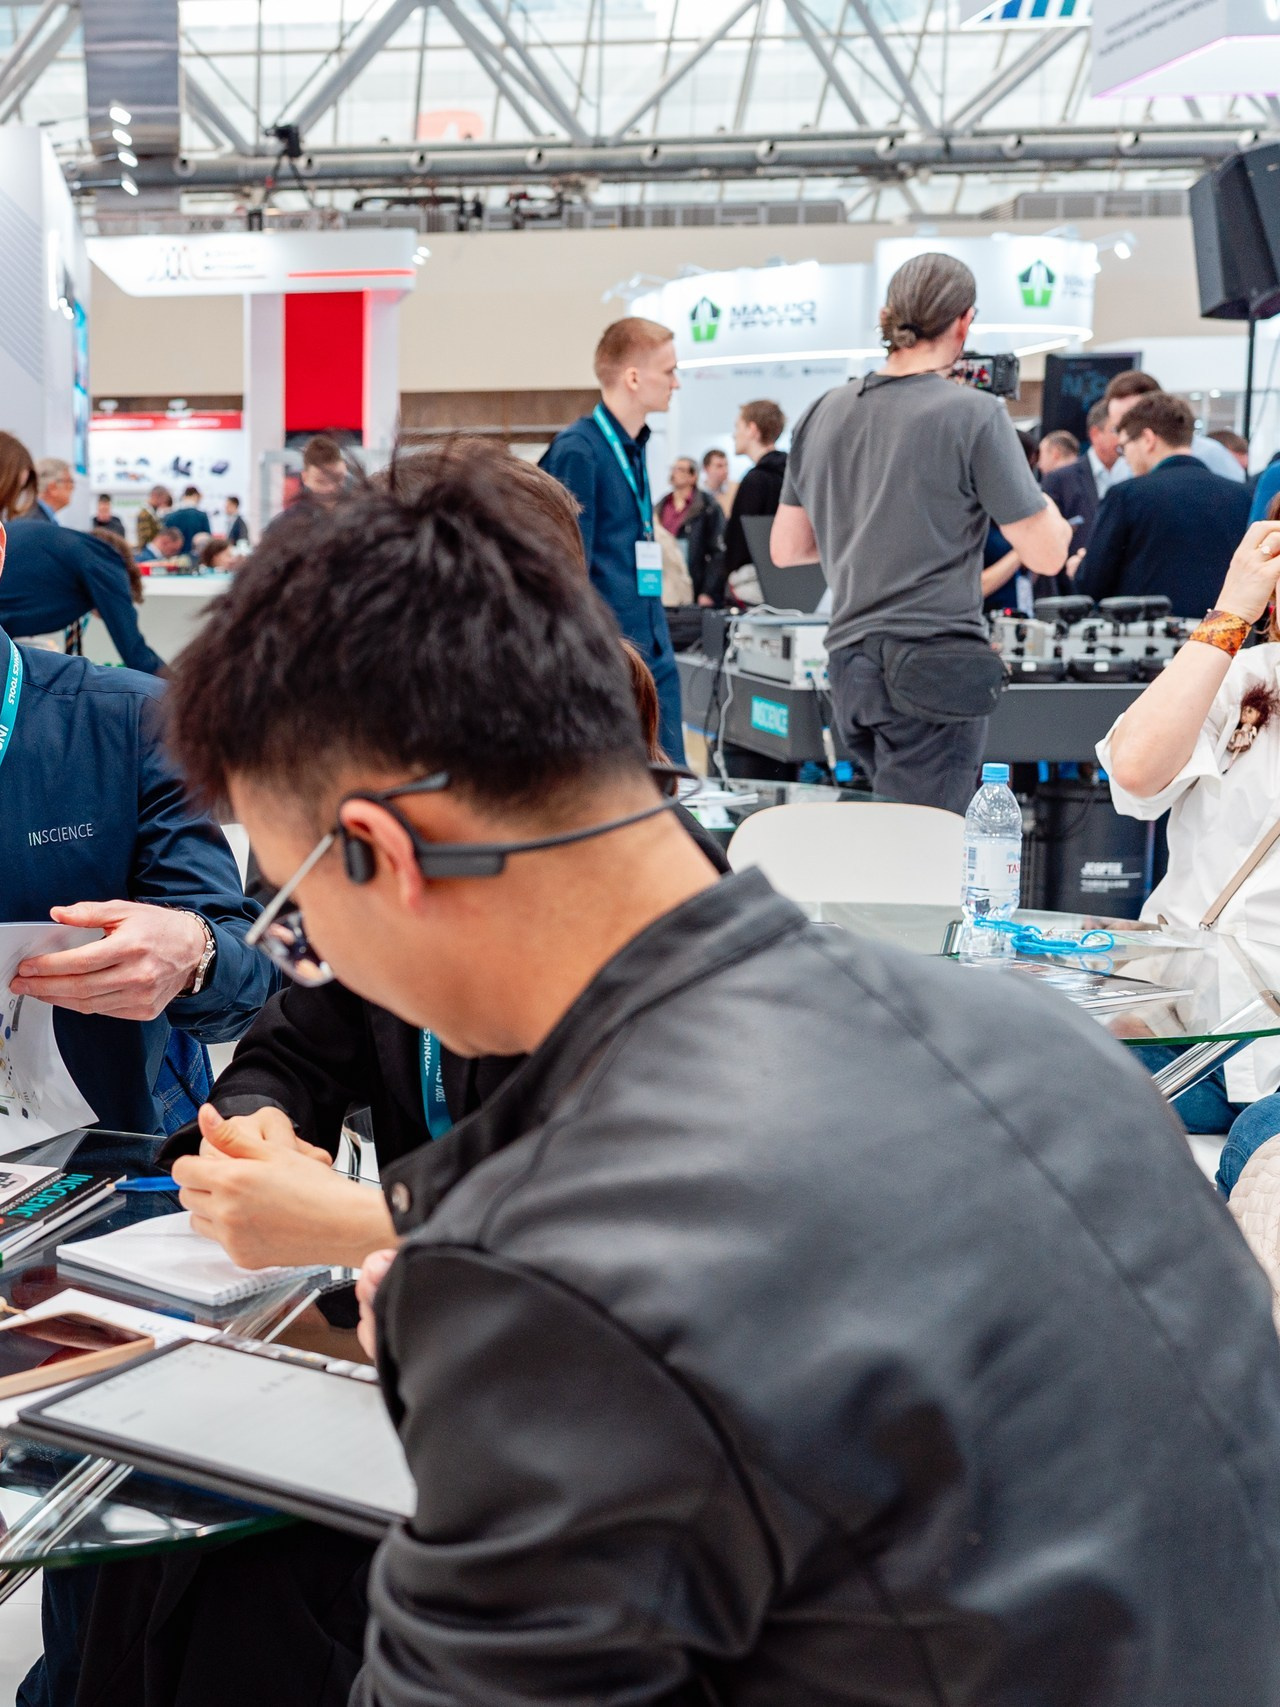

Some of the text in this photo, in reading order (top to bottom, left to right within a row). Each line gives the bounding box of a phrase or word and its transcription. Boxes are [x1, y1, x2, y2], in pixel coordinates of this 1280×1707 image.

[8, 677, 18, 705] TOOLS
[28, 823, 94, 847] INSCIENCE
[7, 1173, 94, 1218] INSCIENC
